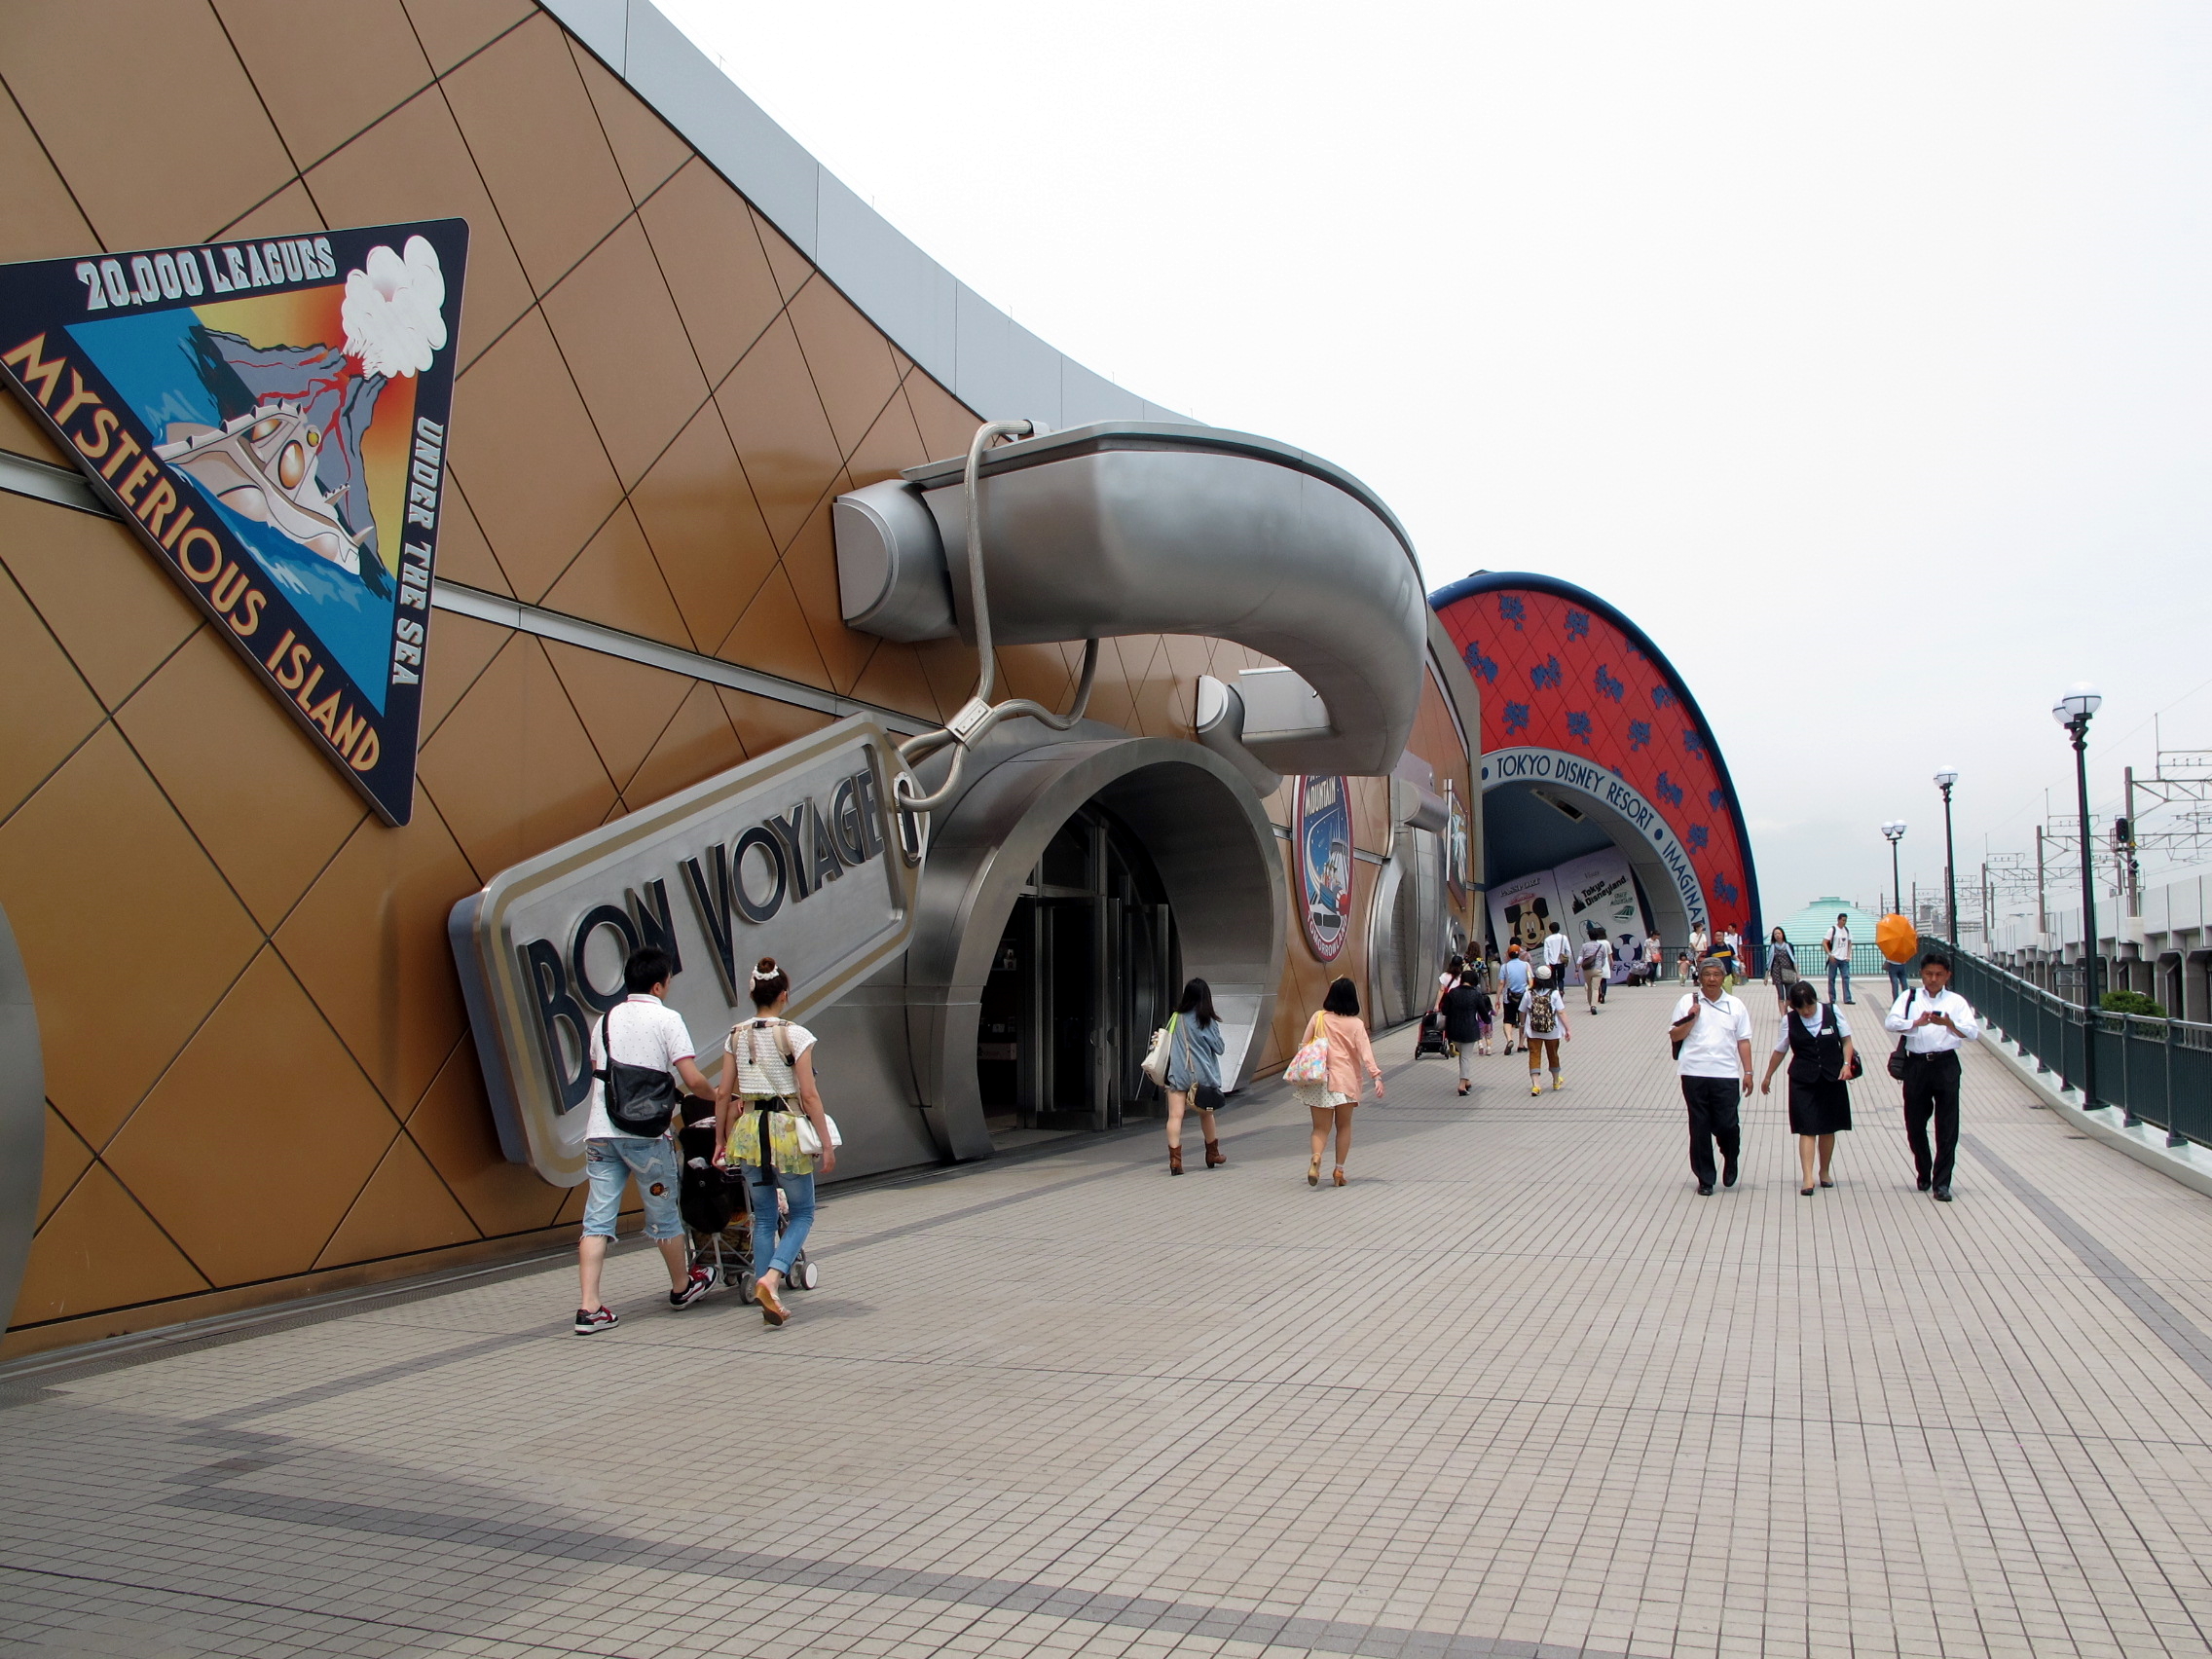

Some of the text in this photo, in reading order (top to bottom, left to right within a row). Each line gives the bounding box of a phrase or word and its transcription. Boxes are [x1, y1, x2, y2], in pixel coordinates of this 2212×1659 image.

[75, 238, 337, 311] 20,000 LEAGUES
[0, 331, 381, 772] MYSTERIOUS ISLAND
[392, 416, 444, 685] UNDER THE SEA
[1305, 775, 1336, 818] MOUNTAIN
[1496, 754, 1654, 830] TOKYO DISNEY RESORT
[1581, 880, 1605, 898] Tokyo
[1585, 875, 1627, 906] Disneyland
[518, 768, 885, 1116] BON VOYAGE
